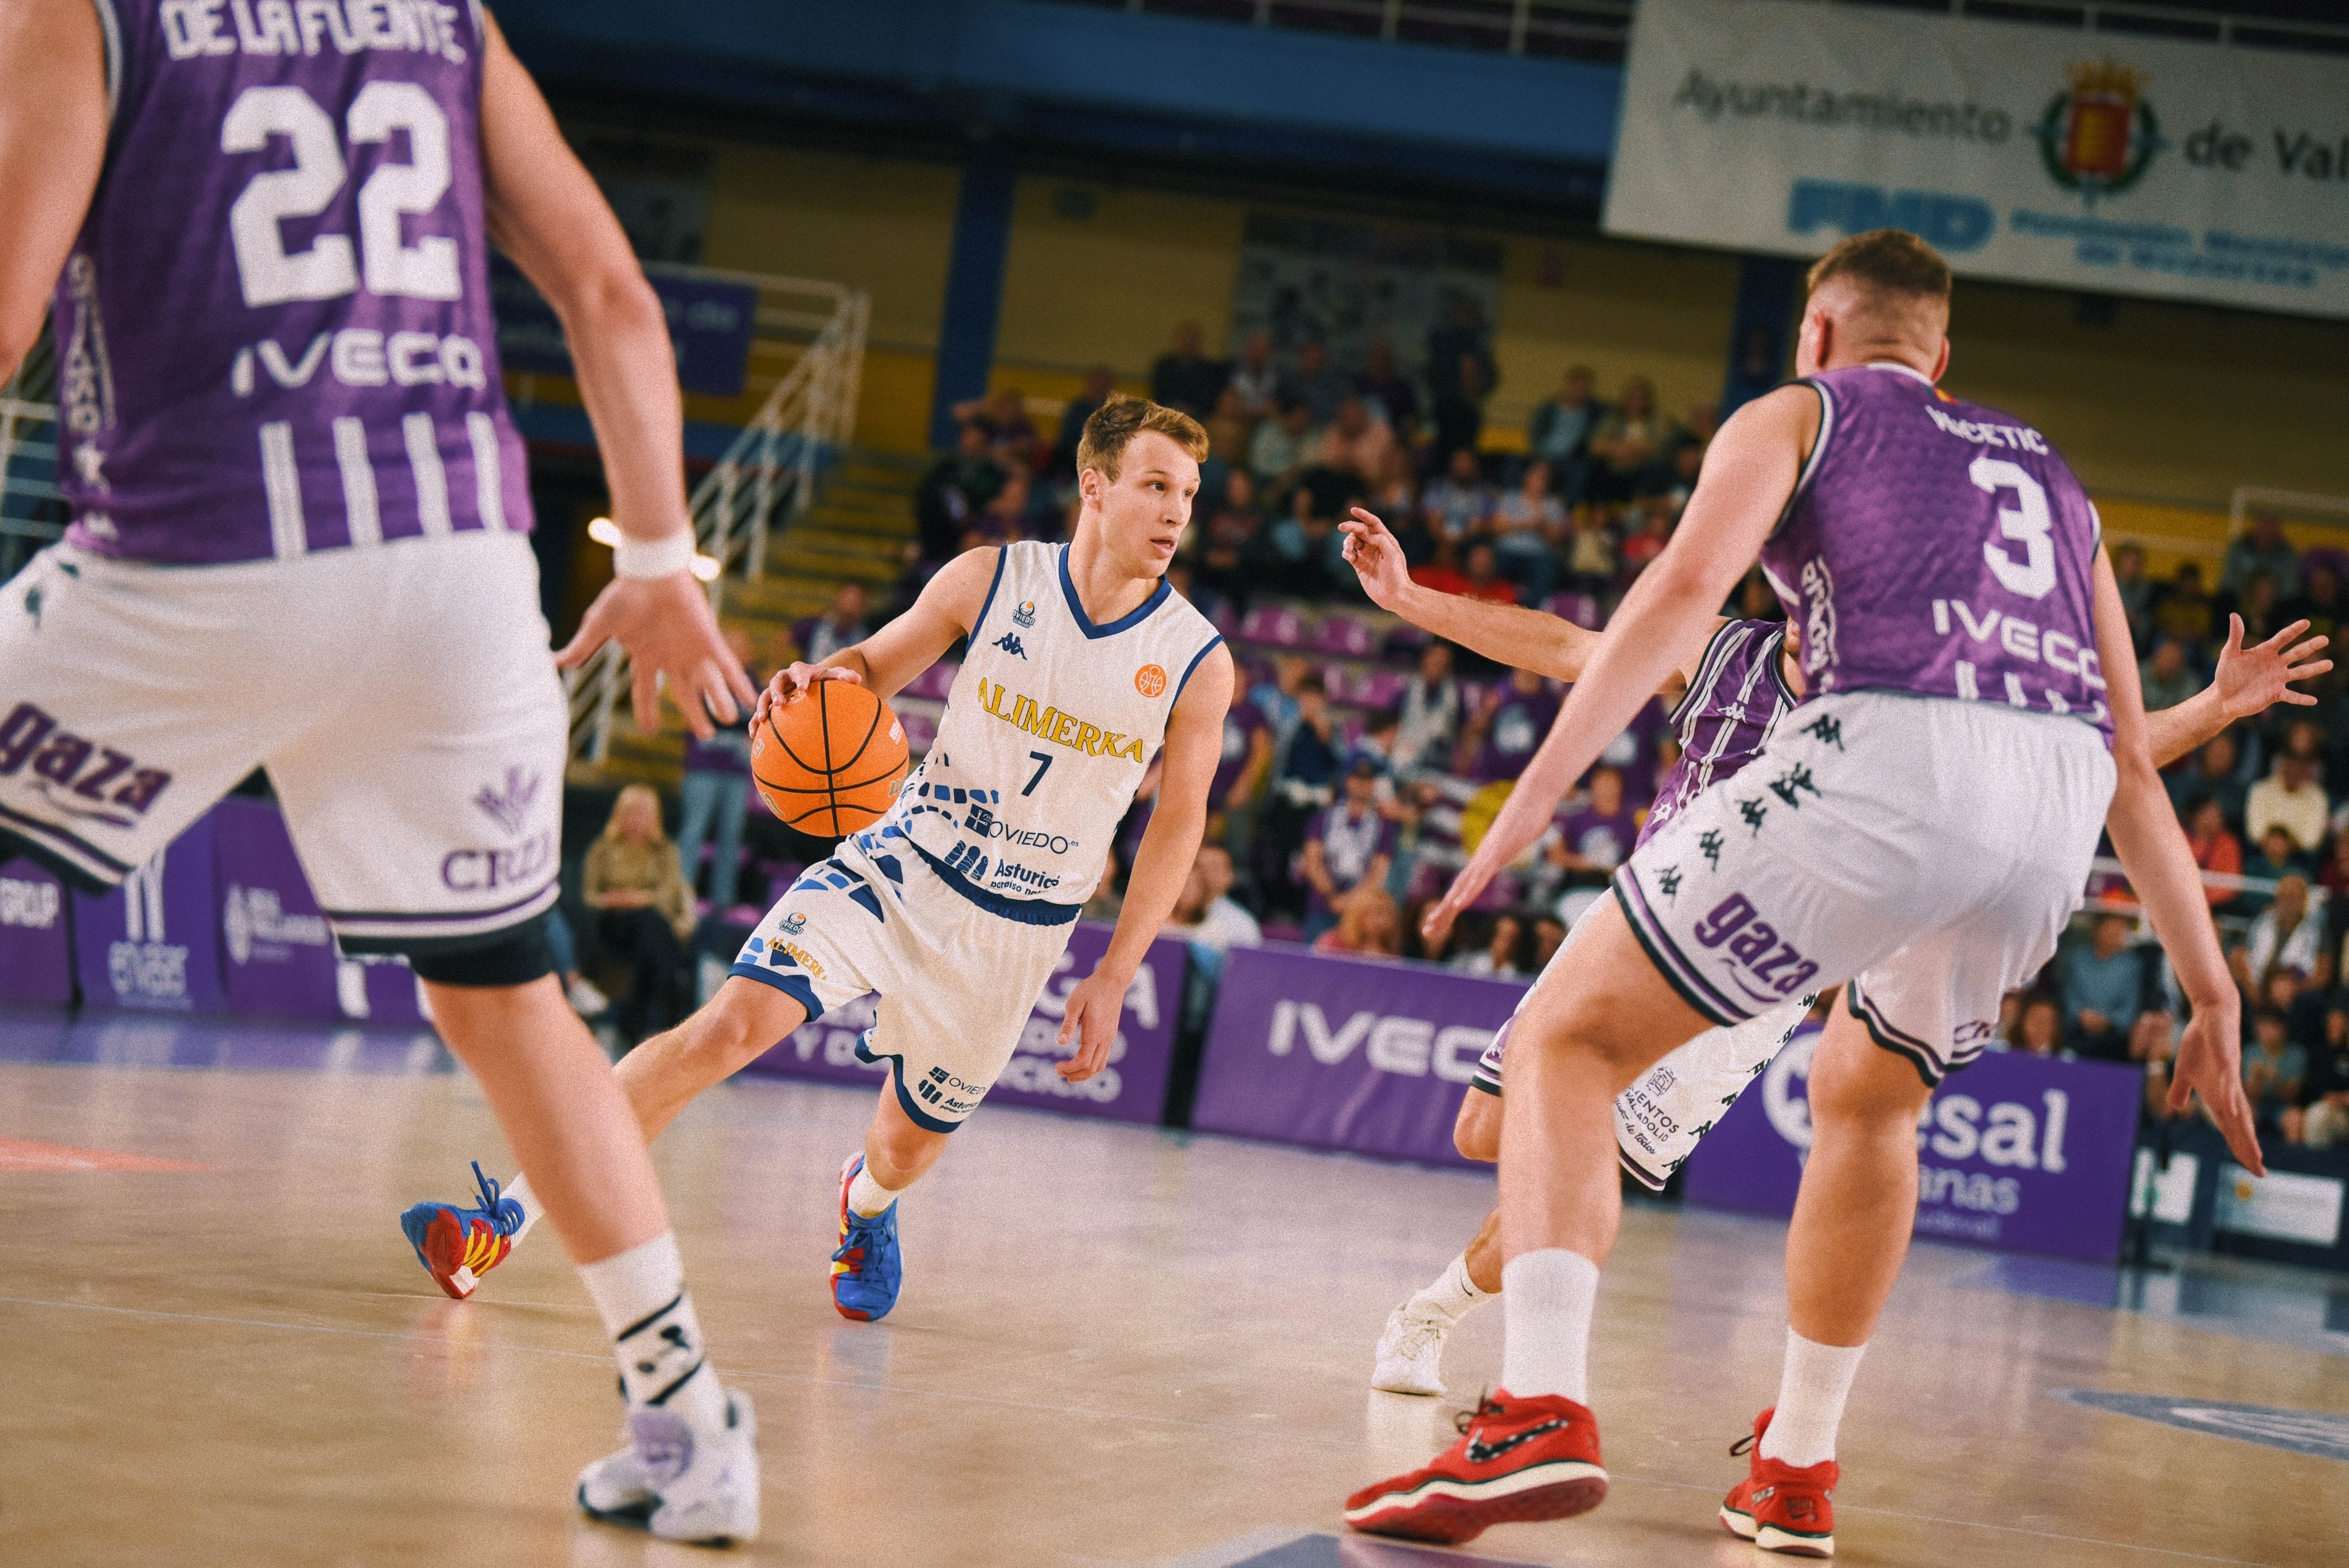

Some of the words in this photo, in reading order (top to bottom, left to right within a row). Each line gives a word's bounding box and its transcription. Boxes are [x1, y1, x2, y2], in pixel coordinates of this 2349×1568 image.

[1673, 65, 2012, 144] Ayuntamiento
[2186, 119, 2252, 171] de
[221, 80, 462, 308] 22
[232, 329, 486, 397] IVECO
[1969, 456, 2057, 600] 3
[1013, 610, 1035, 625] OVIEDO
[977, 677, 1144, 763] ALIMERKA
[0, 702, 173, 815] gaza
[1021, 751, 1053, 797] 7
[764, 936, 828, 980] ALIMERK
[780, 920, 804, 934] OVIEDO
[1695, 891, 1819, 995] gaza
[949, 1078, 986, 1094] OVIED
[1634, 1132, 1656, 1155] todos
